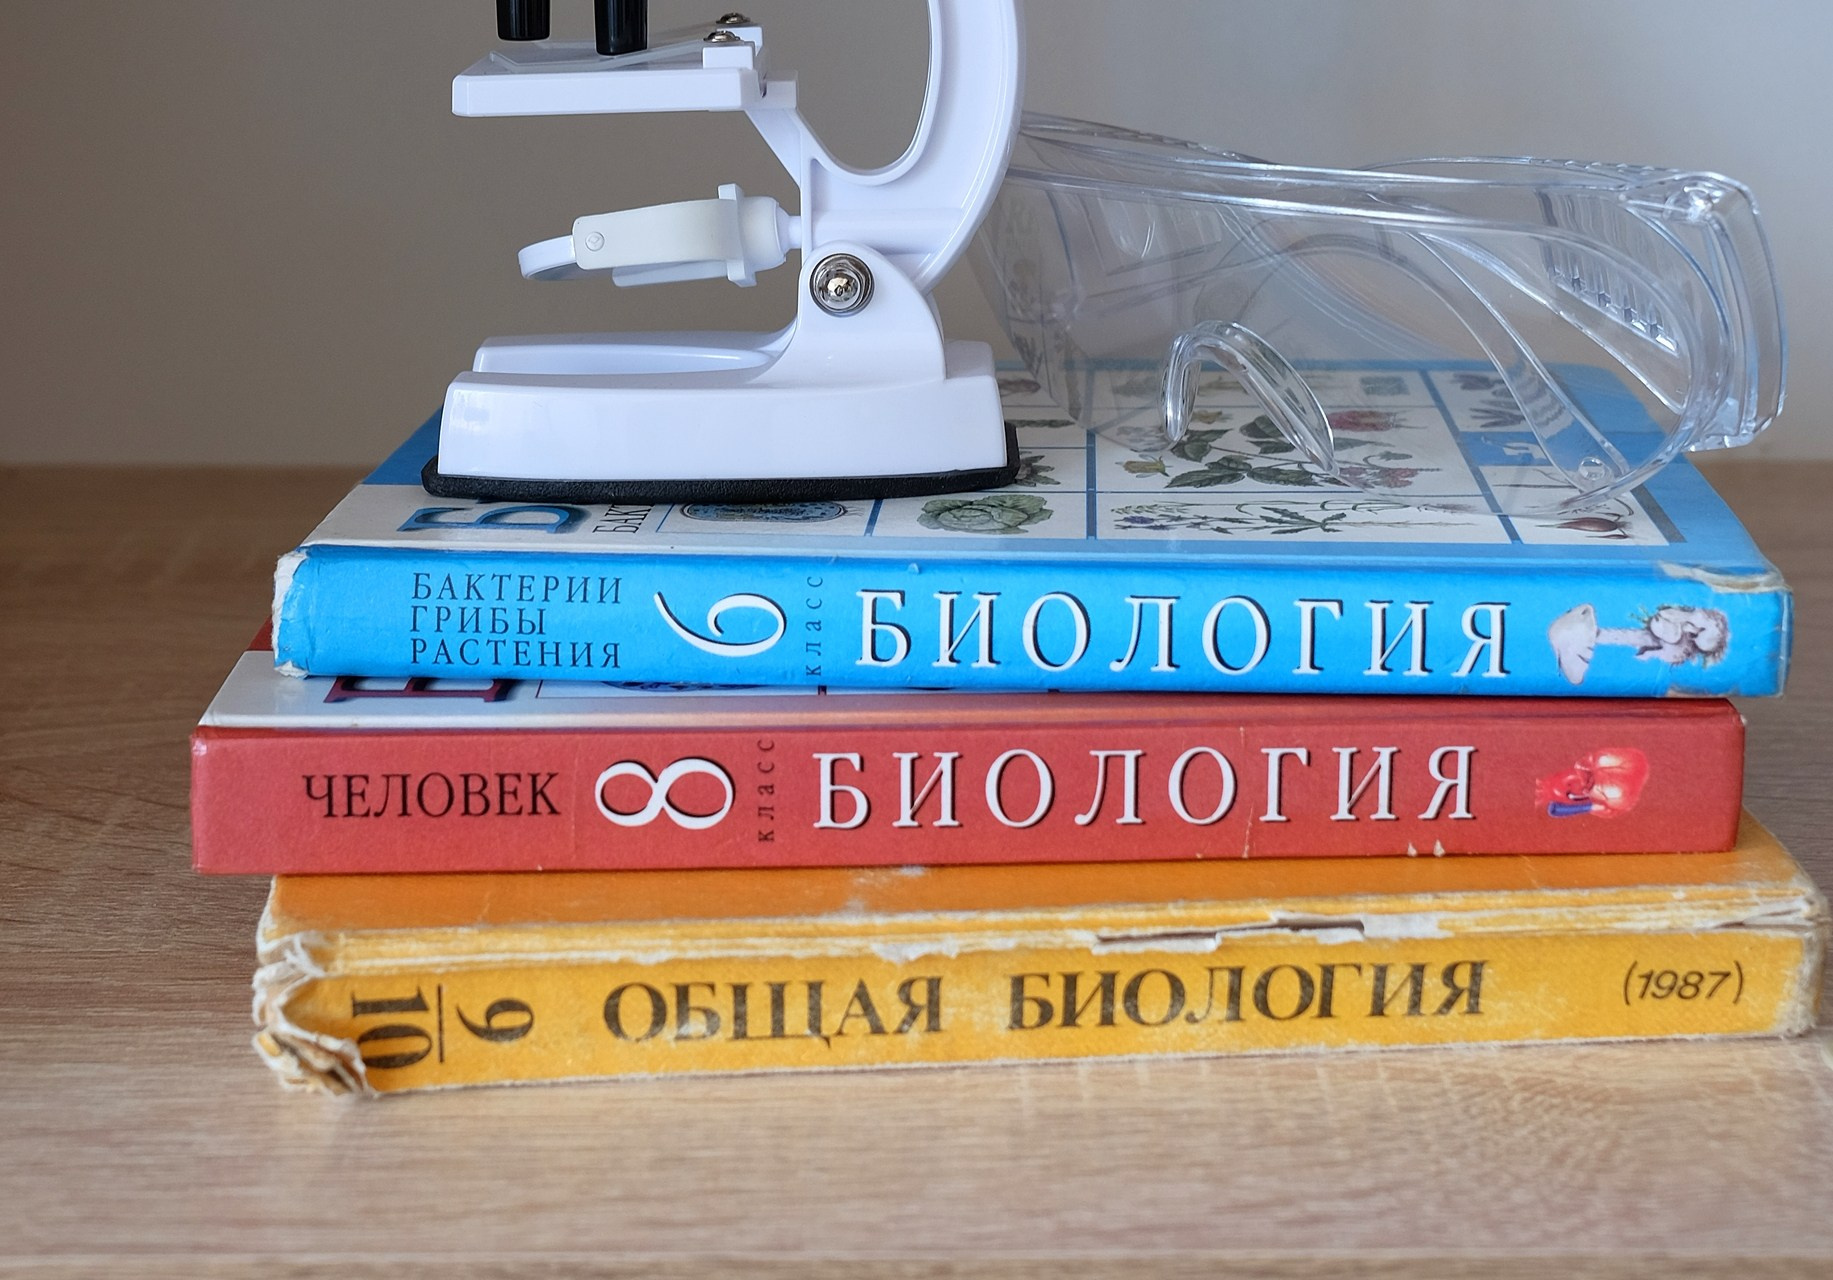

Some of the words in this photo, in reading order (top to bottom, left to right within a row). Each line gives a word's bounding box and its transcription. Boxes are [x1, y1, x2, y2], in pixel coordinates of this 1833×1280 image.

[410, 606, 545, 635] ГРИБЫ
[411, 572, 623, 604] БАКТЕРИИ
[805, 576, 824, 677] класс
[410, 638, 621, 668] РАСТЕНИЯ
[855, 588, 1511, 678] БИОЛОГИЯ
[302, 772, 561, 818] ЧЕЛОВЕК
[594, 757, 736, 829] 8
[757, 739, 776, 843] класс
[812, 745, 1478, 830] БИОЛОГИЯ
[602, 975, 945, 1048] ОБЩАЯ
[1006, 960, 1491, 1032] БИОЛОГИЯ
[1623, 960, 1745, 1006] (1987)
